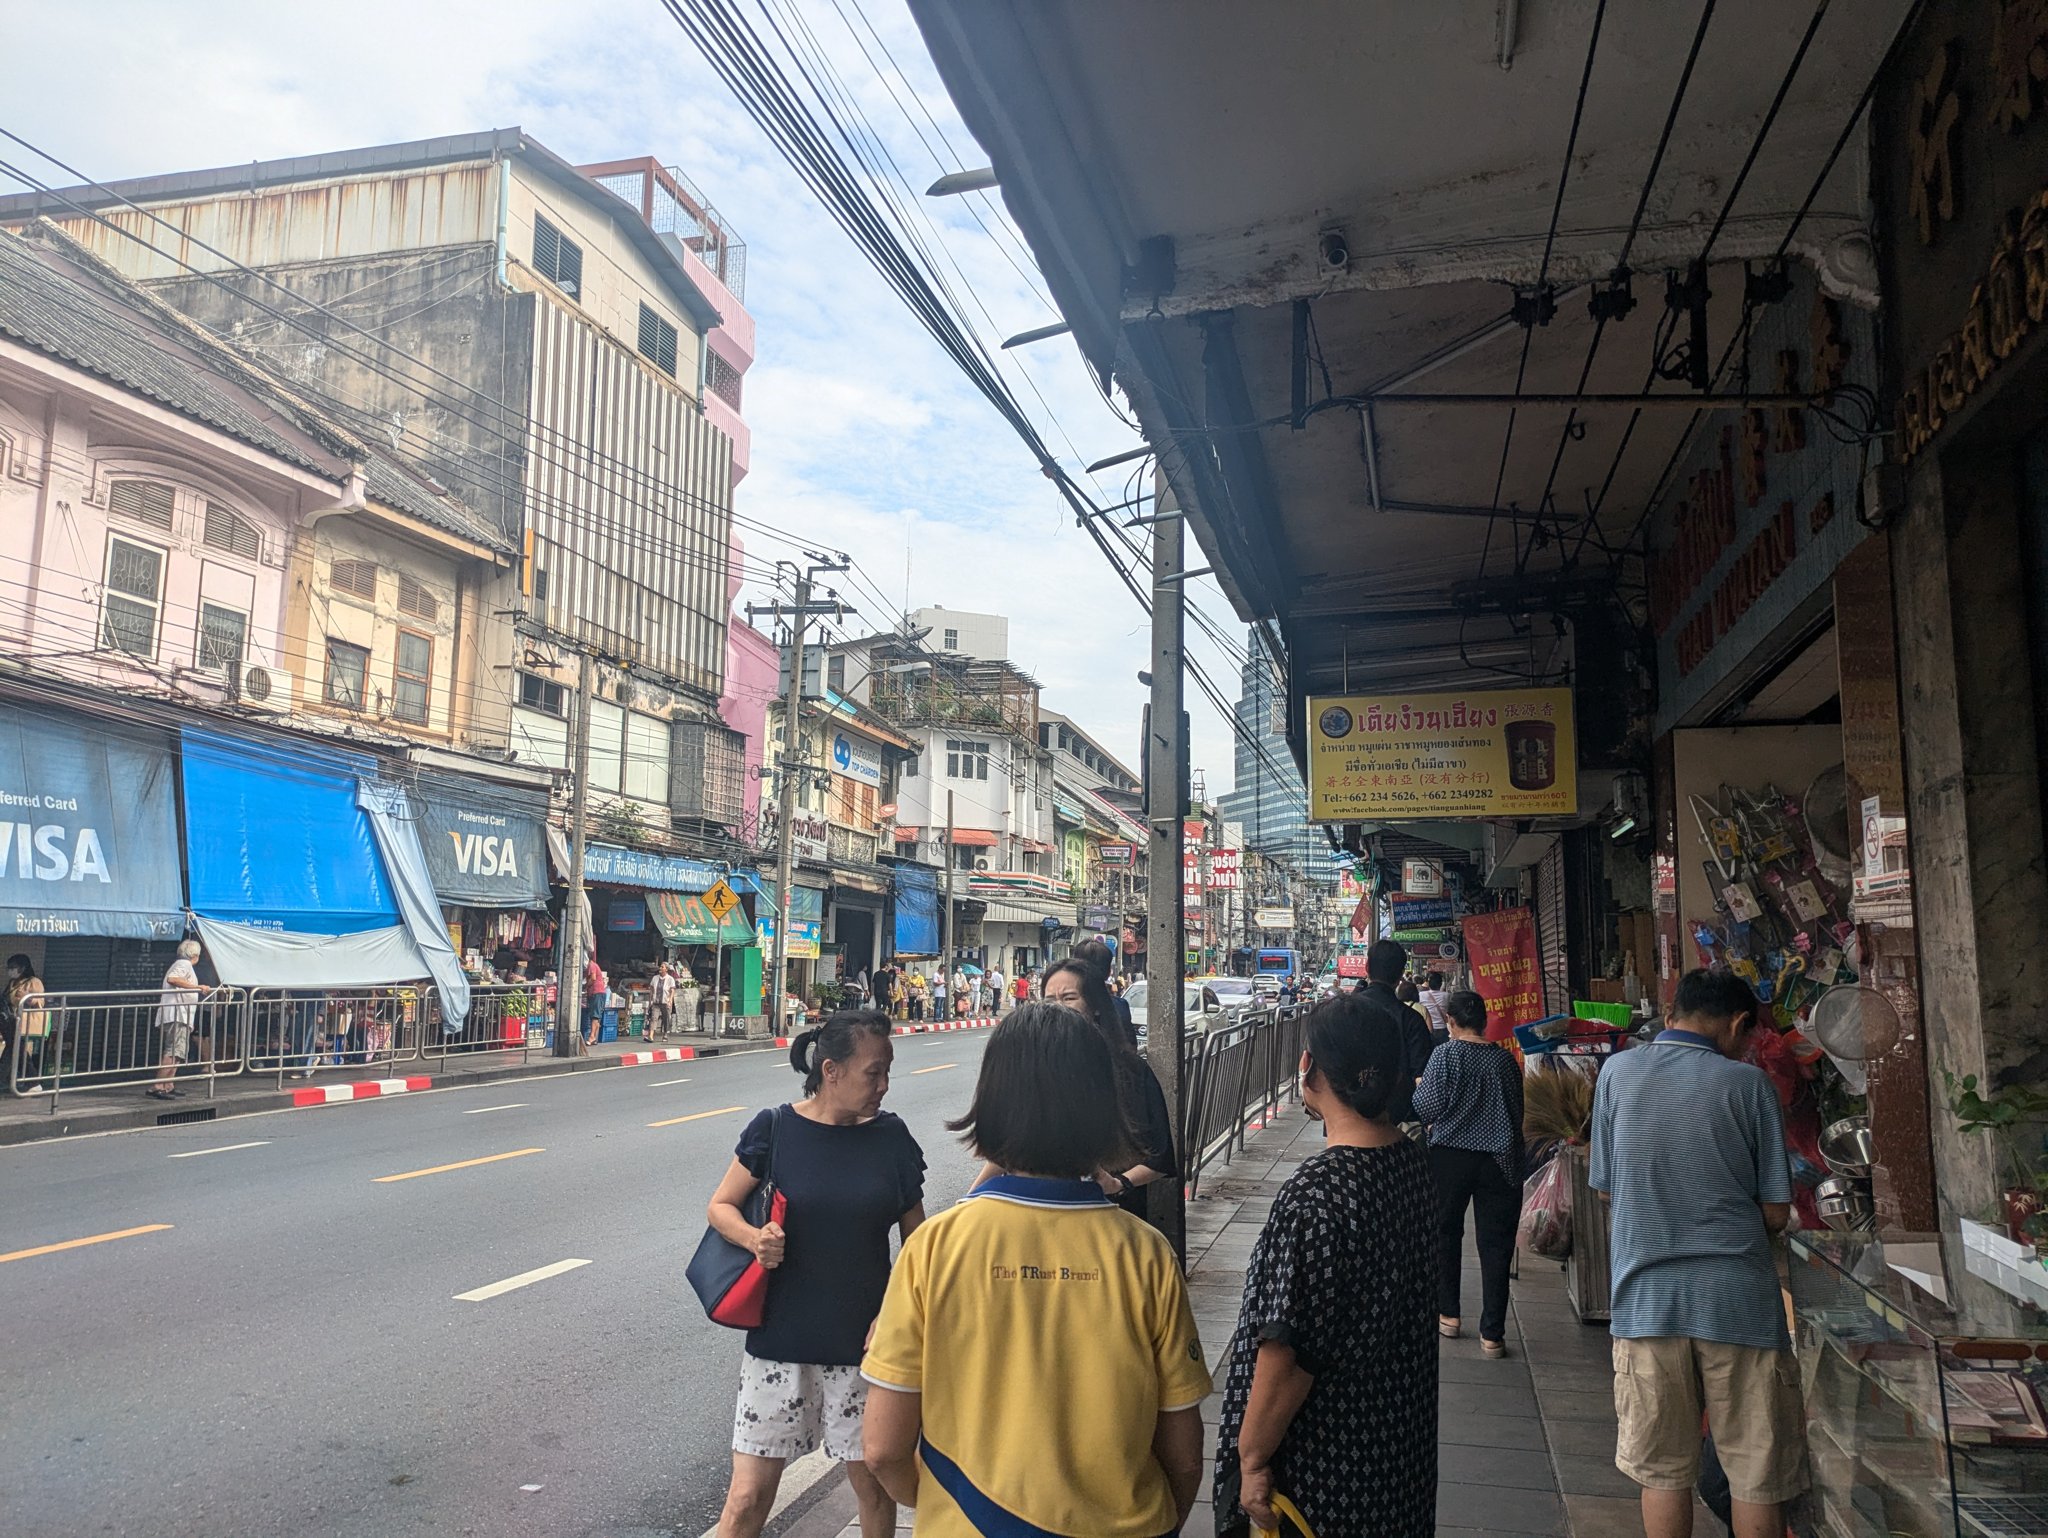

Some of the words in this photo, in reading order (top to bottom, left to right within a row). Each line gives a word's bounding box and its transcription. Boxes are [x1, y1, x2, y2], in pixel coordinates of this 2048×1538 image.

[1321, 741, 1356, 753] จำหน่าย
[1359, 740, 1392, 754] หมูแผ่น
[0, 791, 40, 808] ferred
[44, 795, 78, 811] Card
[1322, 793, 1367, 803] Tel:+662
[1371, 792, 1388, 802] 234
[1391, 791, 1418, 803] 5626,
[1421, 790, 1447, 800] +662
[1450, 789, 1493, 799] 2349282
[458, 810, 489, 824] Preferred
[490, 815, 506, 827] Card
[447, 831, 518, 878] VISA
[16, 913, 79, 933] จินดาวัฒนา
[147, 919, 175, 935] VISA
[1394, 931, 1440, 940] Pharmacy
[729, 1018, 745, 1030] 46
[992, 1265, 1017, 1280] The
[1020, 1265, 1056, 1280] TRust
[1059, 1266, 1099, 1281] Brand
